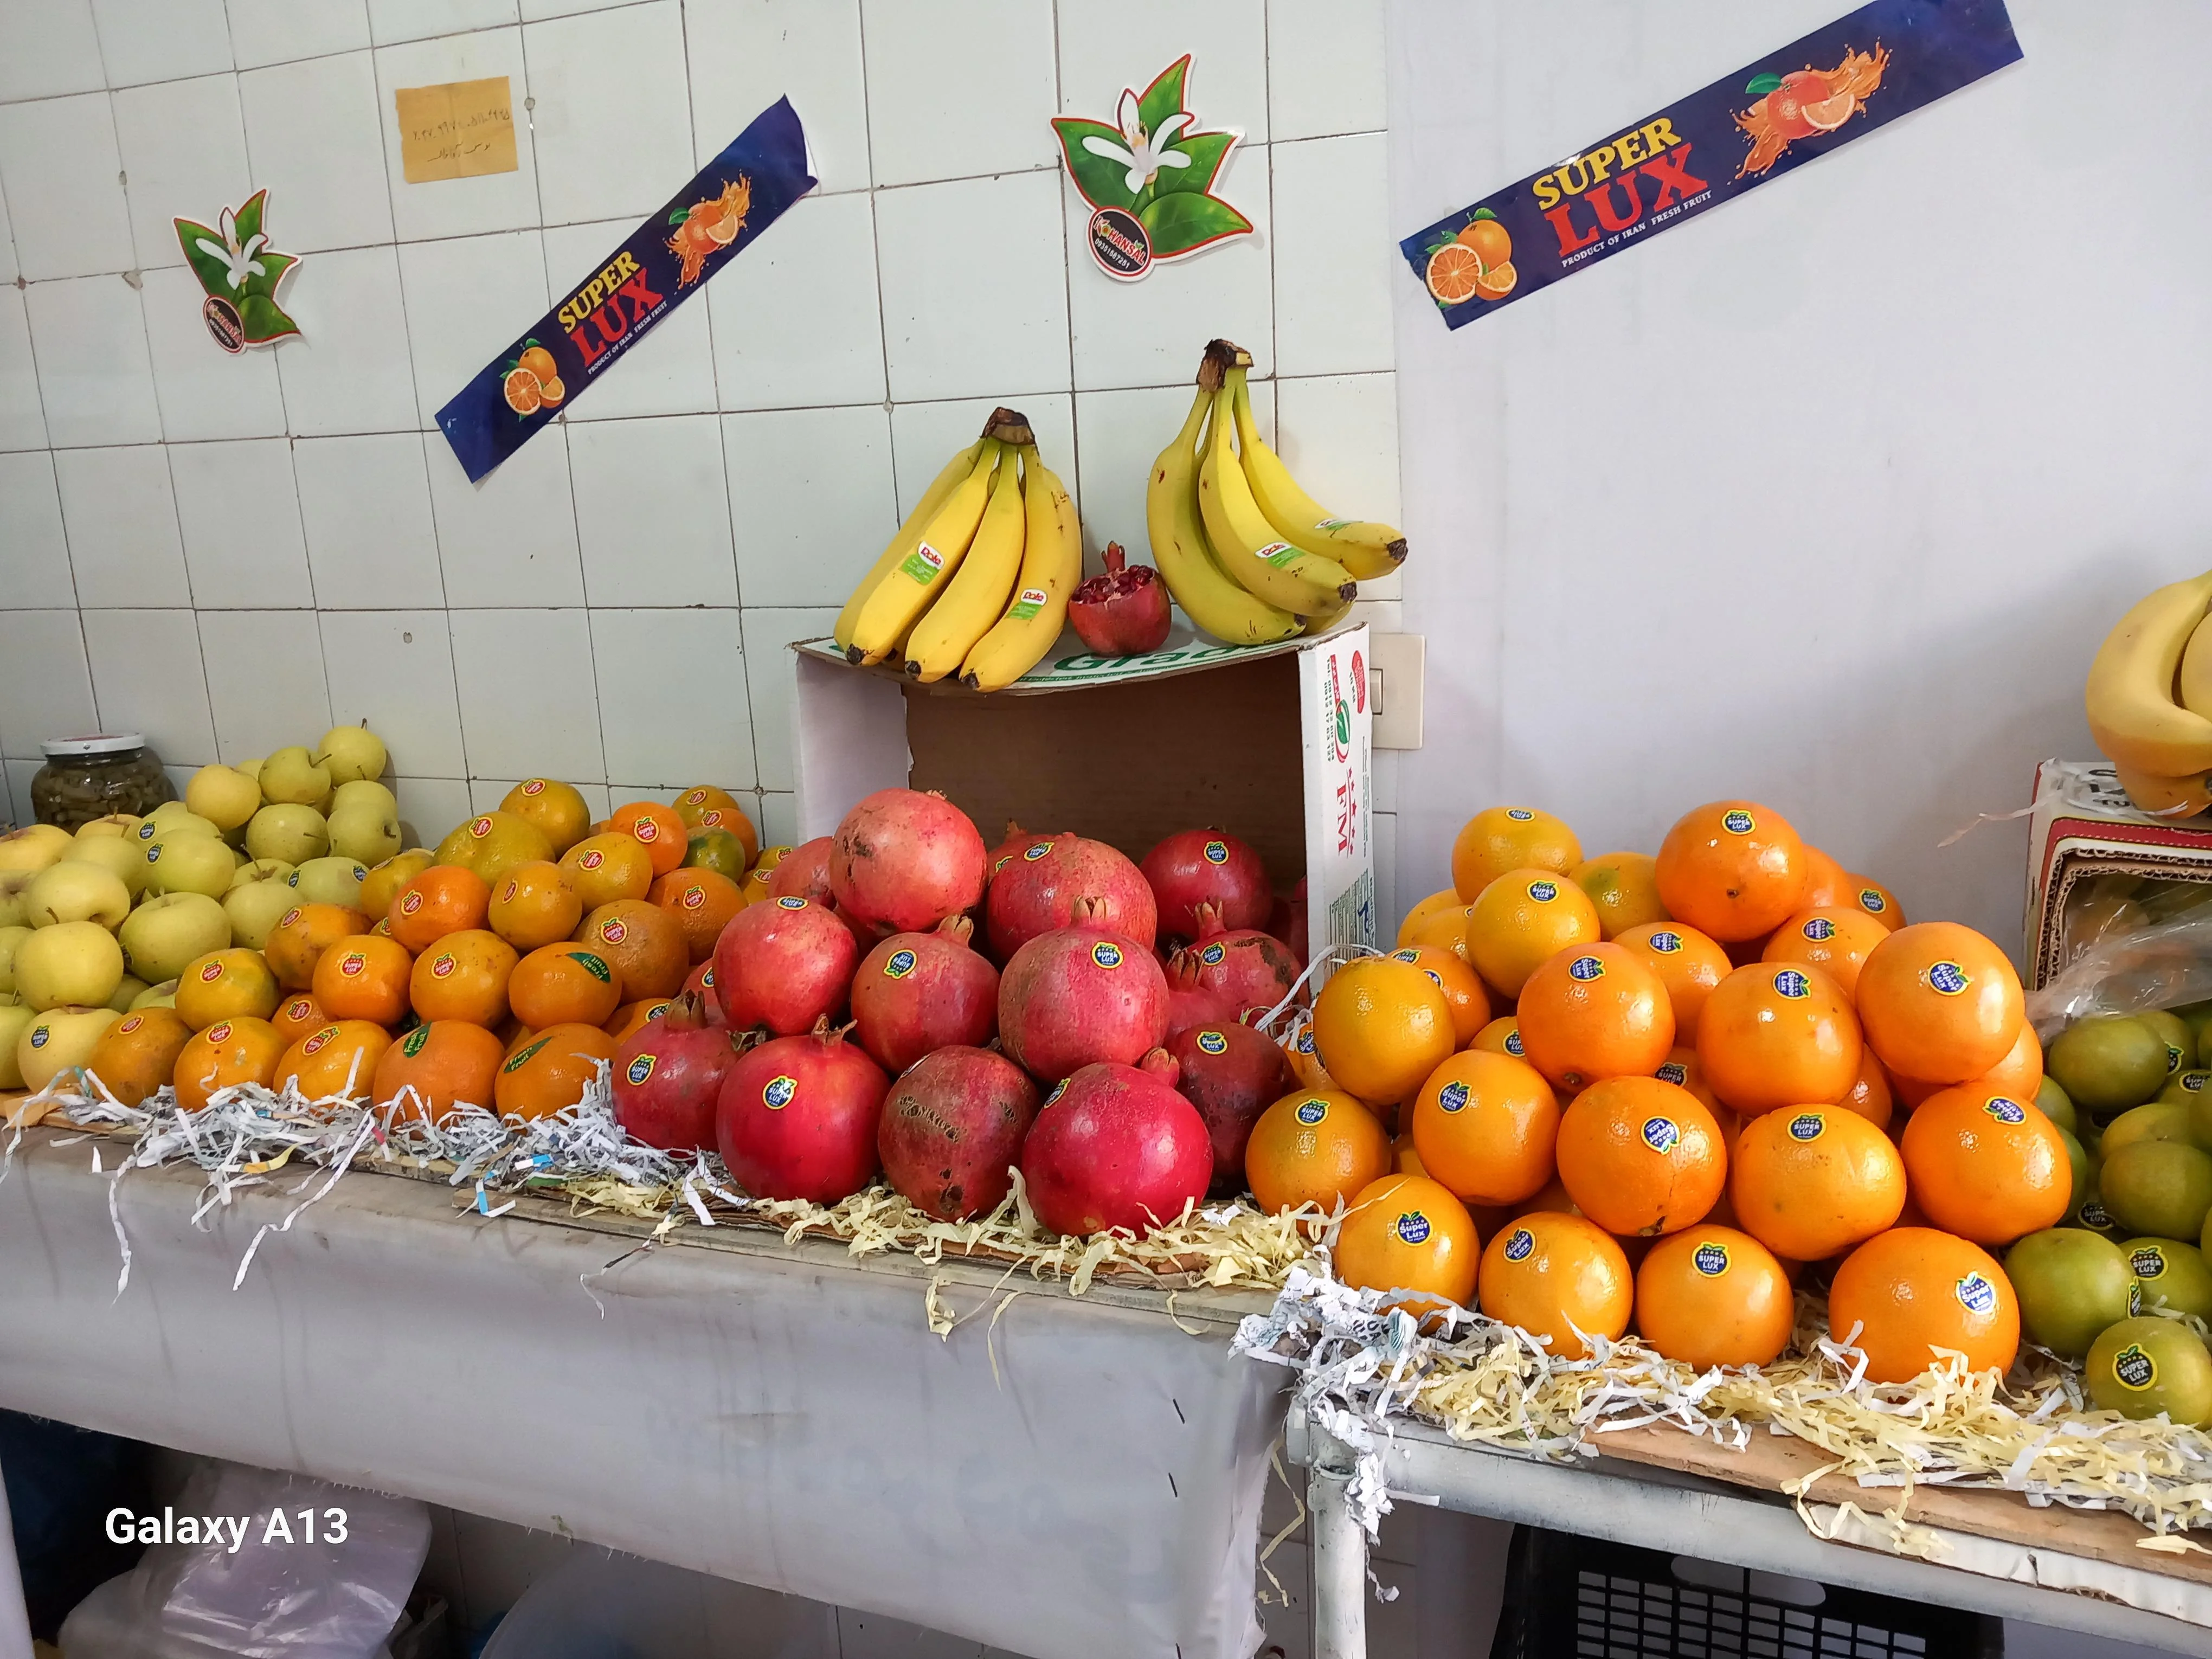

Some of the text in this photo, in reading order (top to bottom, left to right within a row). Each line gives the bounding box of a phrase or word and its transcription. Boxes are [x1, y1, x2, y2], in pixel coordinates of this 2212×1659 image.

[1533, 117, 1681, 210] SUPER
[1544, 143, 1708, 258] LUX
[1561, 190, 1712, 268] PRODUCT OF IRAN FRESH FRUIT
[558, 251, 640, 332] SUPER
[570, 268, 664, 368] LUX
[588, 351, 612, 374] PRODUCT
[634, 315, 652, 333] FRESH
[1097, 950, 1117, 959] SUPER
[1933, 971, 1948, 988] Lux
[1937, 964, 1958, 991] Super
[632, 1066, 648, 1074] SUPER
[1658, 1071, 1682, 1082] SUPER
[769, 1094, 782, 1104] LUX
[1301, 1108, 1323, 1117] SUPER
[1303, 1113, 1316, 1121] LUX
[1648, 1121, 1666, 1134] Lux
[1793, 1122, 1819, 1130] SUPER
[1649, 1123, 1676, 1143] Super
[1399, 1222, 1429, 1234] Super
[1507, 1234, 1529, 1257] Super
[1514, 1243, 1530, 1257] Lux
[1698, 1255, 1725, 1265] SUPER
[1702, 1262, 1719, 1270] LUX
[2133, 1259, 2161, 1268] SUPER
[2138, 1265, 2156, 1273] LUX
[2120, 1359, 2149, 1377] SUPER
[2129, 1369, 2148, 1382] LUX
